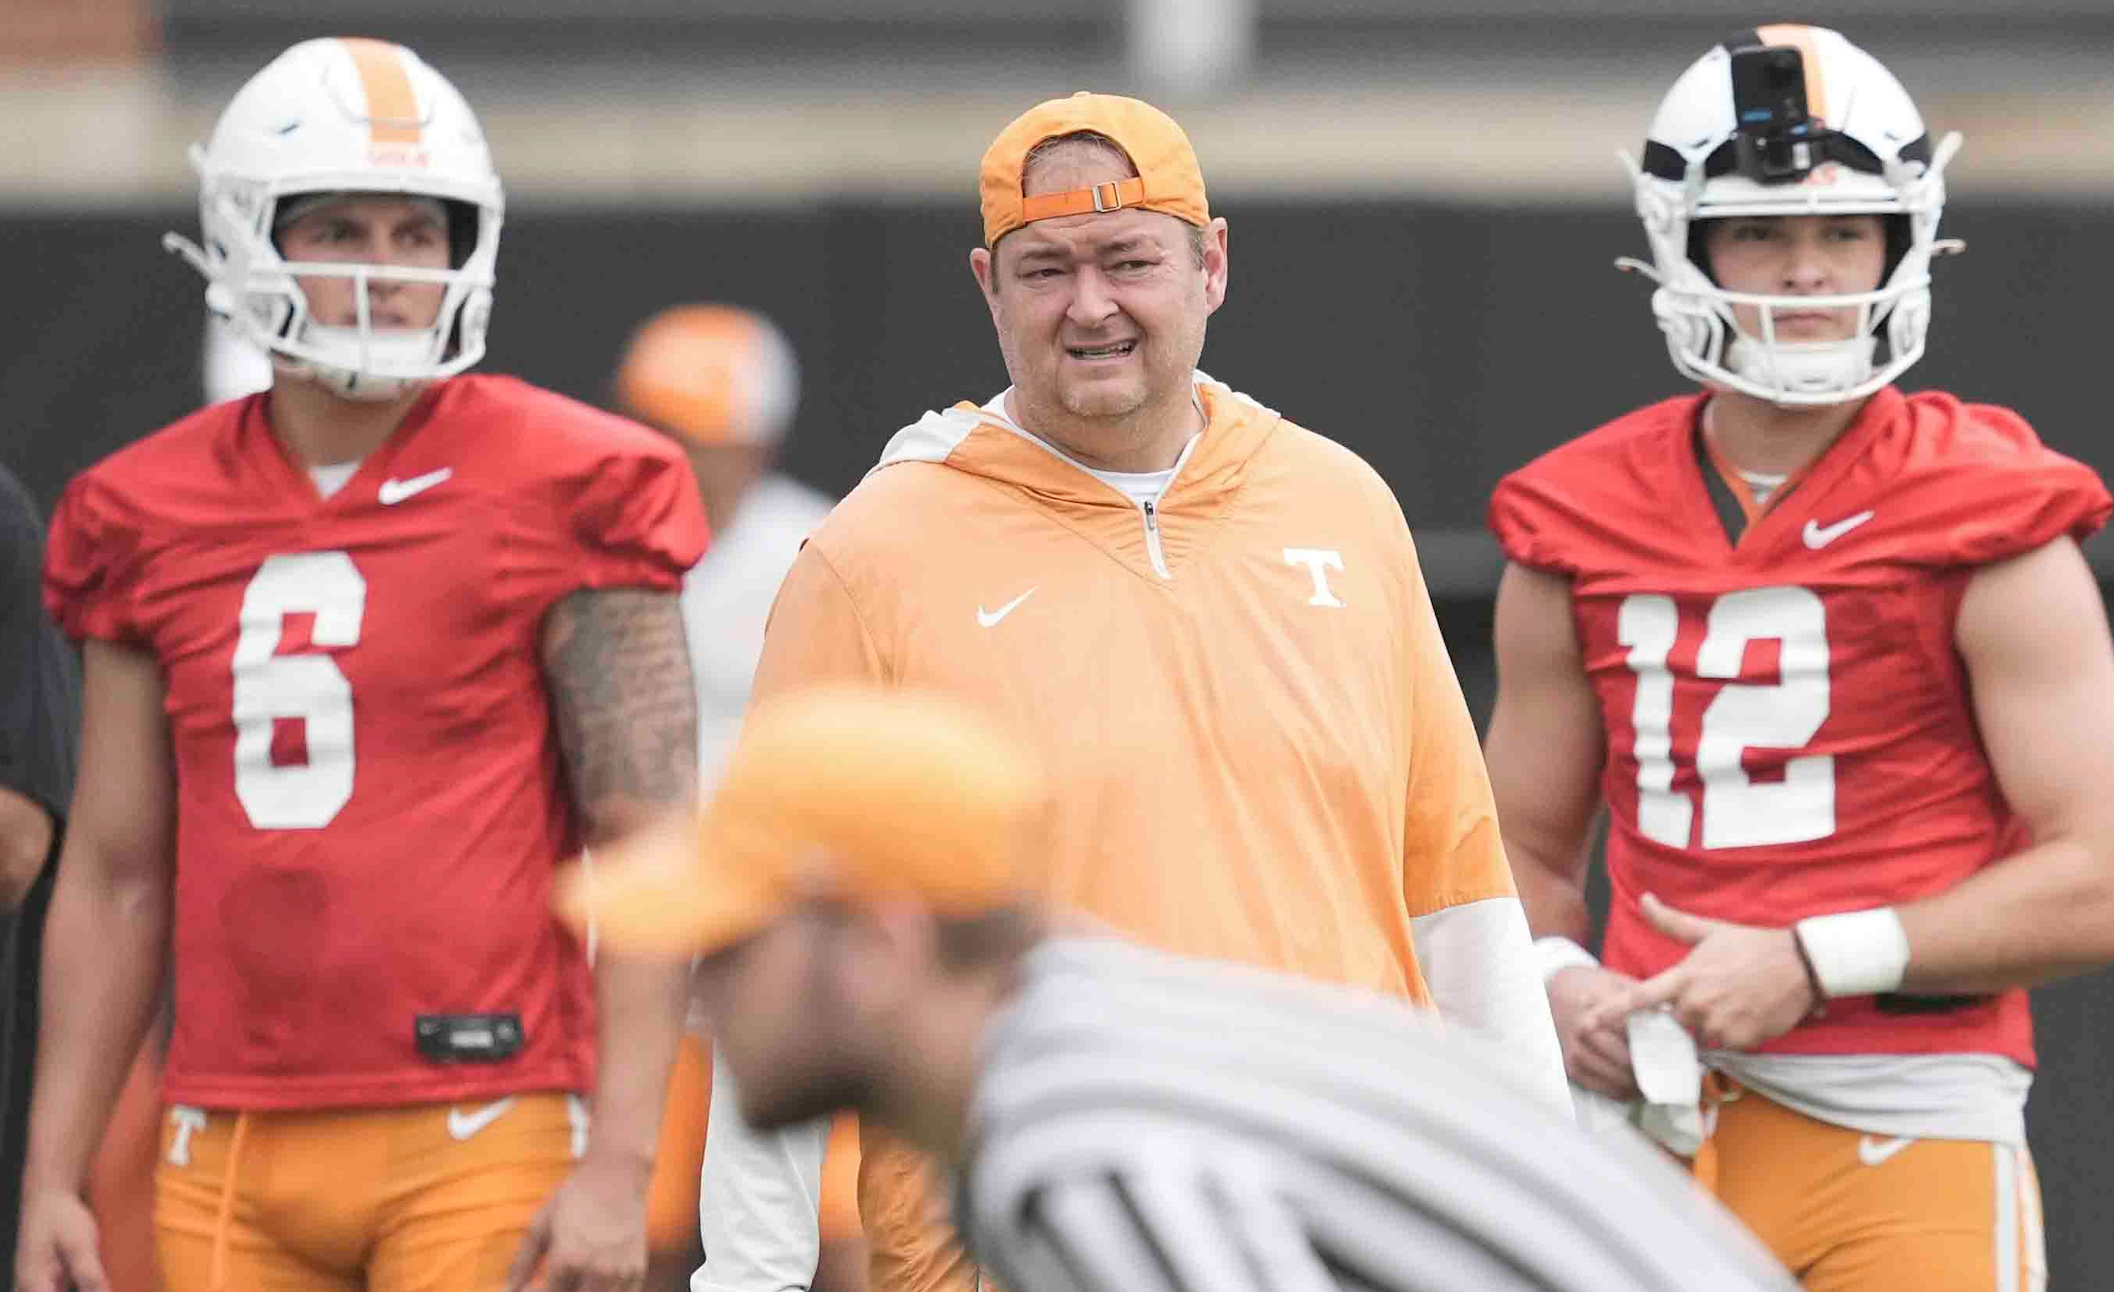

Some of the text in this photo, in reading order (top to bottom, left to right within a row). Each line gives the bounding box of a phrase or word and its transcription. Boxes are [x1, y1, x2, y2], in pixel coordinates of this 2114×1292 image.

[1283, 548, 1346, 608] T
[232, 551, 367, 829] 6
[1618, 585, 1836, 850] 12
[167, 1105, 207, 1164] T
